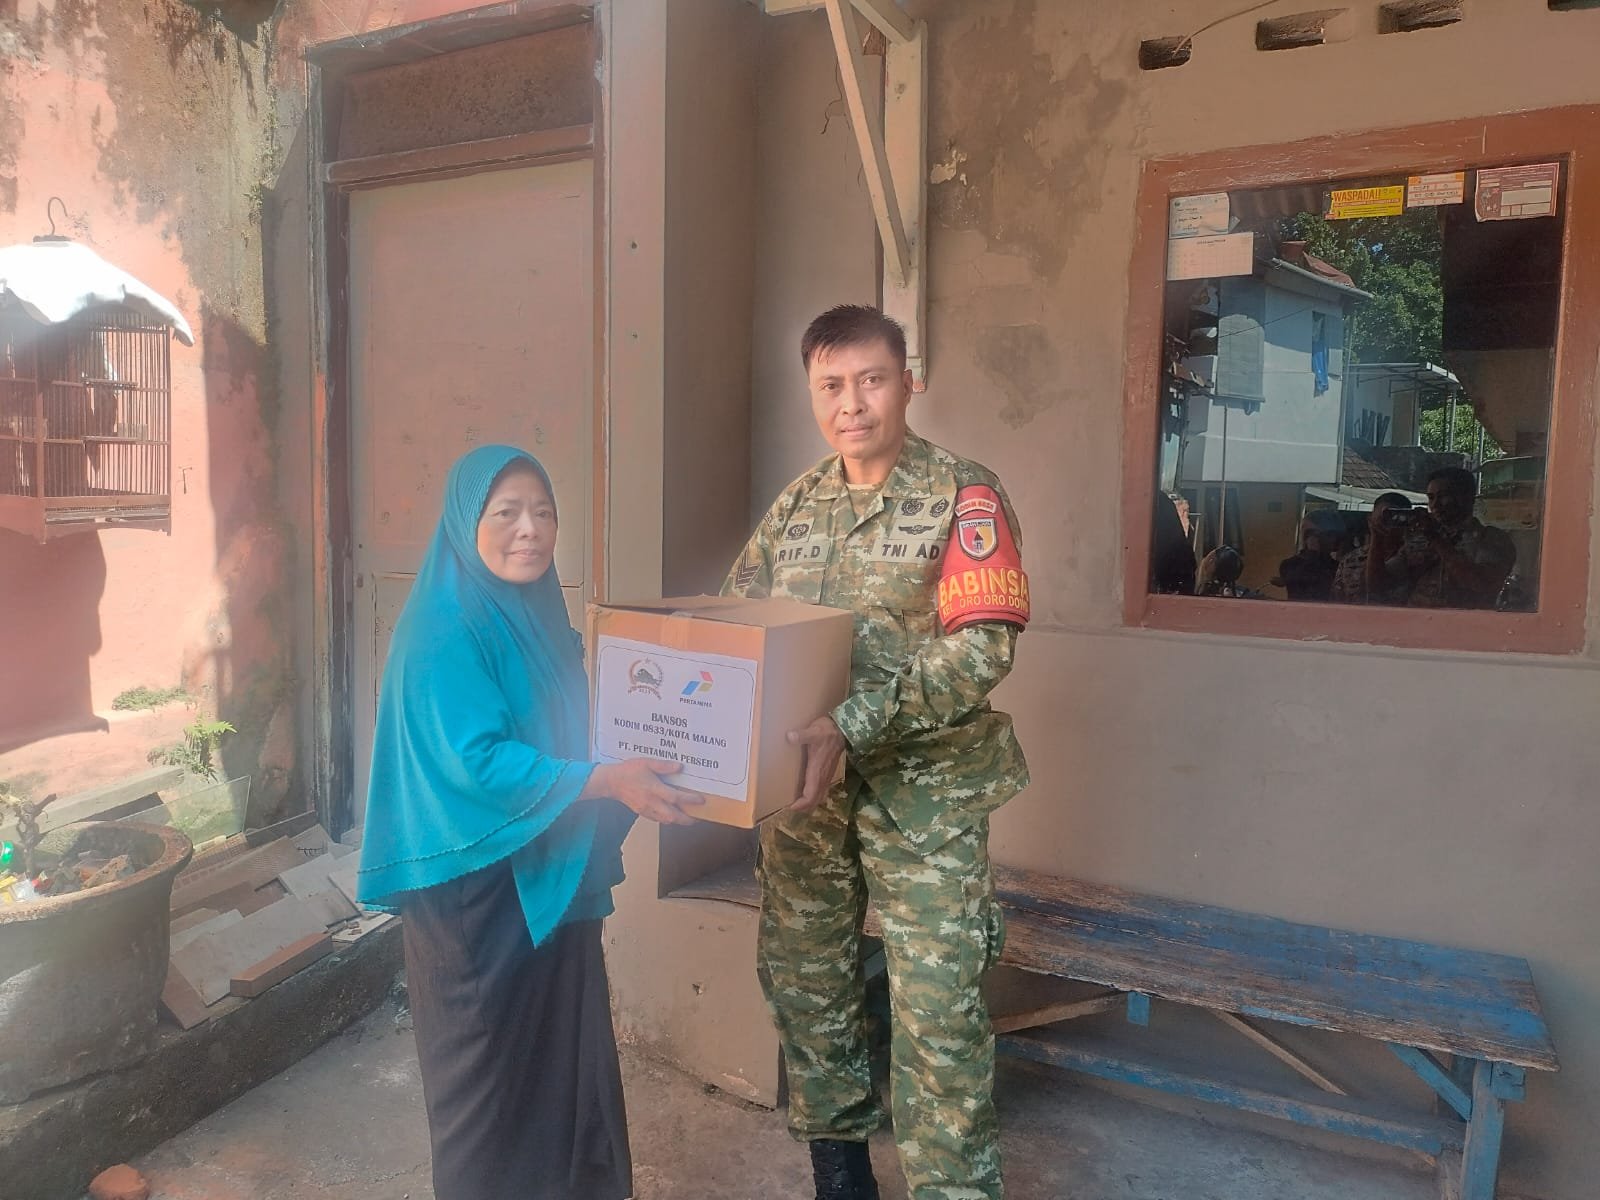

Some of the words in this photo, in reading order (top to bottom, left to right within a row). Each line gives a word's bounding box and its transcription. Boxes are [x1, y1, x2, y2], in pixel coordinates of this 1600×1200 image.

[1333, 189, 1381, 202] WASPADA!!
[882, 543, 908, 557] TNI
[915, 542, 940, 560] AD
[940, 567, 1029, 607] BABINSA
[960, 595, 981, 609] ORO
[983, 594, 1006, 606] ORO
[651, 712, 688, 728] BANSOS
[614, 717, 641, 731] KODIM
[642, 723, 690, 741] 0833/KOTA
[692, 733, 727, 748] MALANG
[660, 738, 677, 749] DAN
[618, 741, 631, 751] PT.
[633, 744, 679, 761] PERTAMINA
[680, 753, 719, 769] PERSERO
